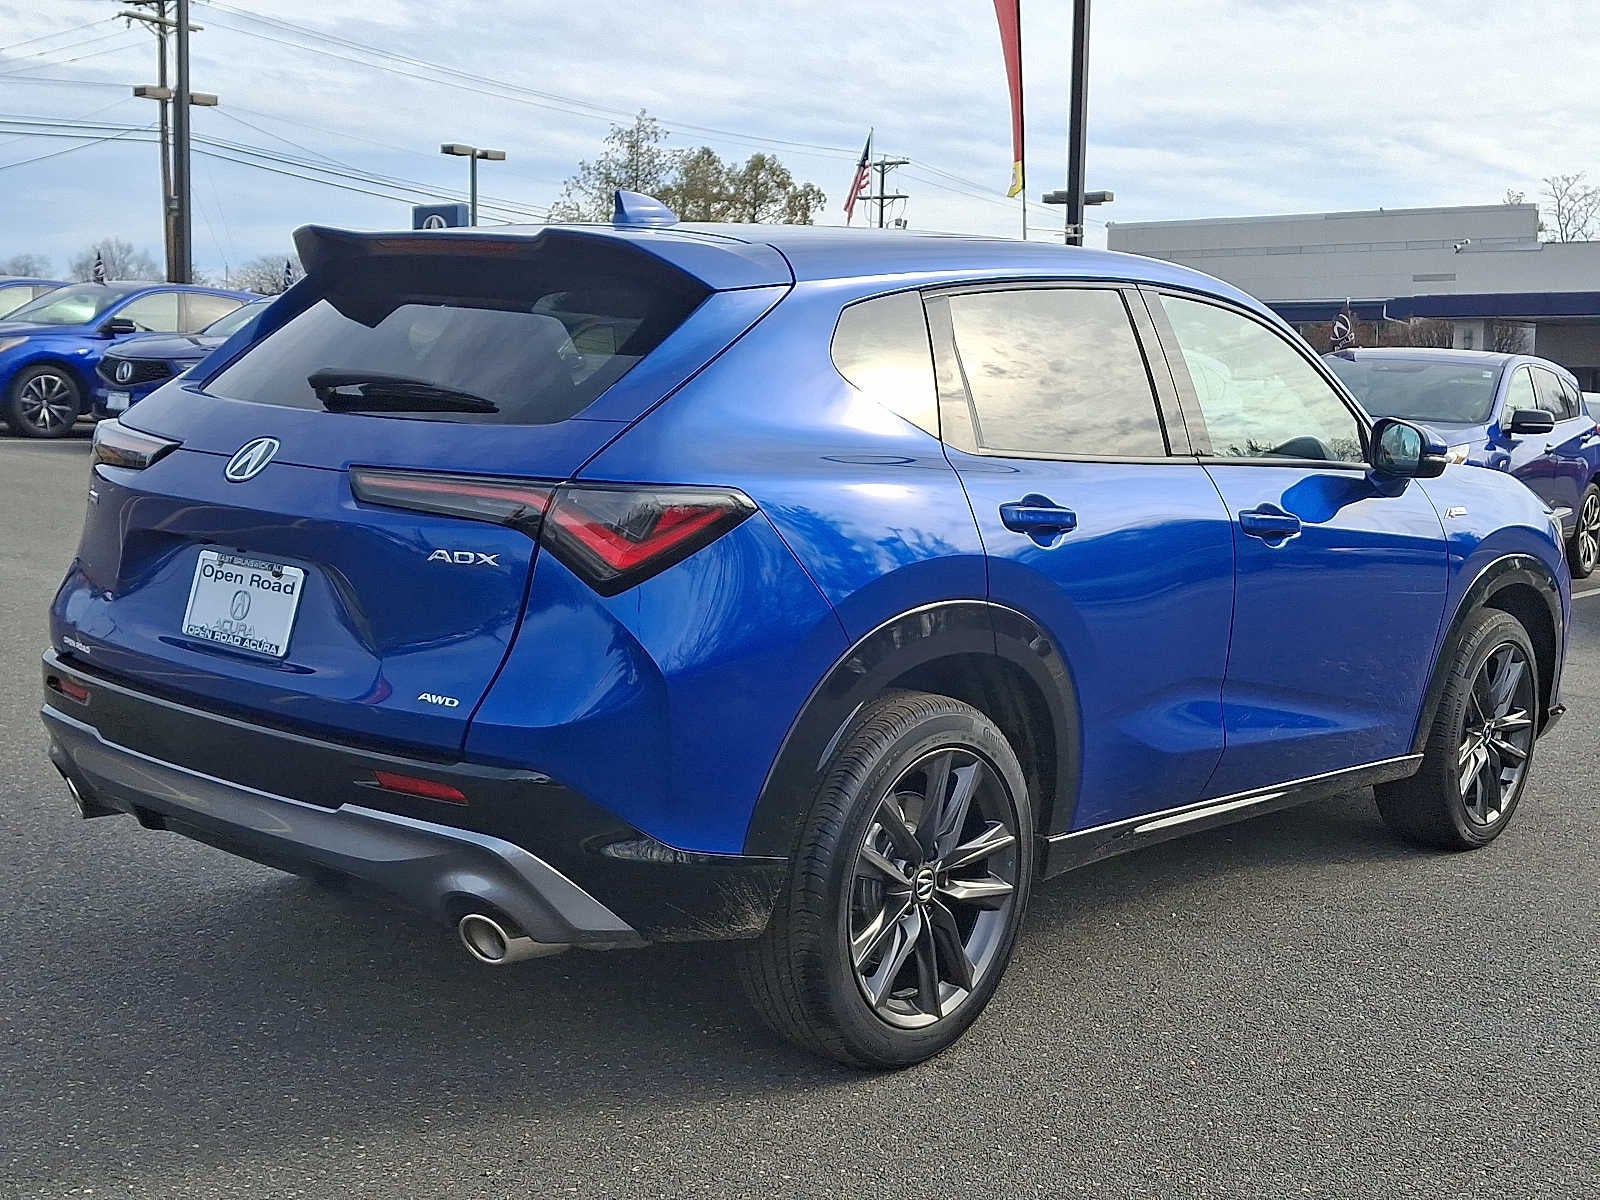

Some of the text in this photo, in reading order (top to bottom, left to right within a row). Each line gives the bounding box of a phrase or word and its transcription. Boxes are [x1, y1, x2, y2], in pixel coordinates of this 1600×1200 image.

[427, 549, 501, 567] ADX
[203, 563, 295, 595] Open Road
[212, 617, 255, 638] ACURA
[187, 625, 277, 654] OPEN ROAD ACURA
[417, 692, 460, 708] AWD
